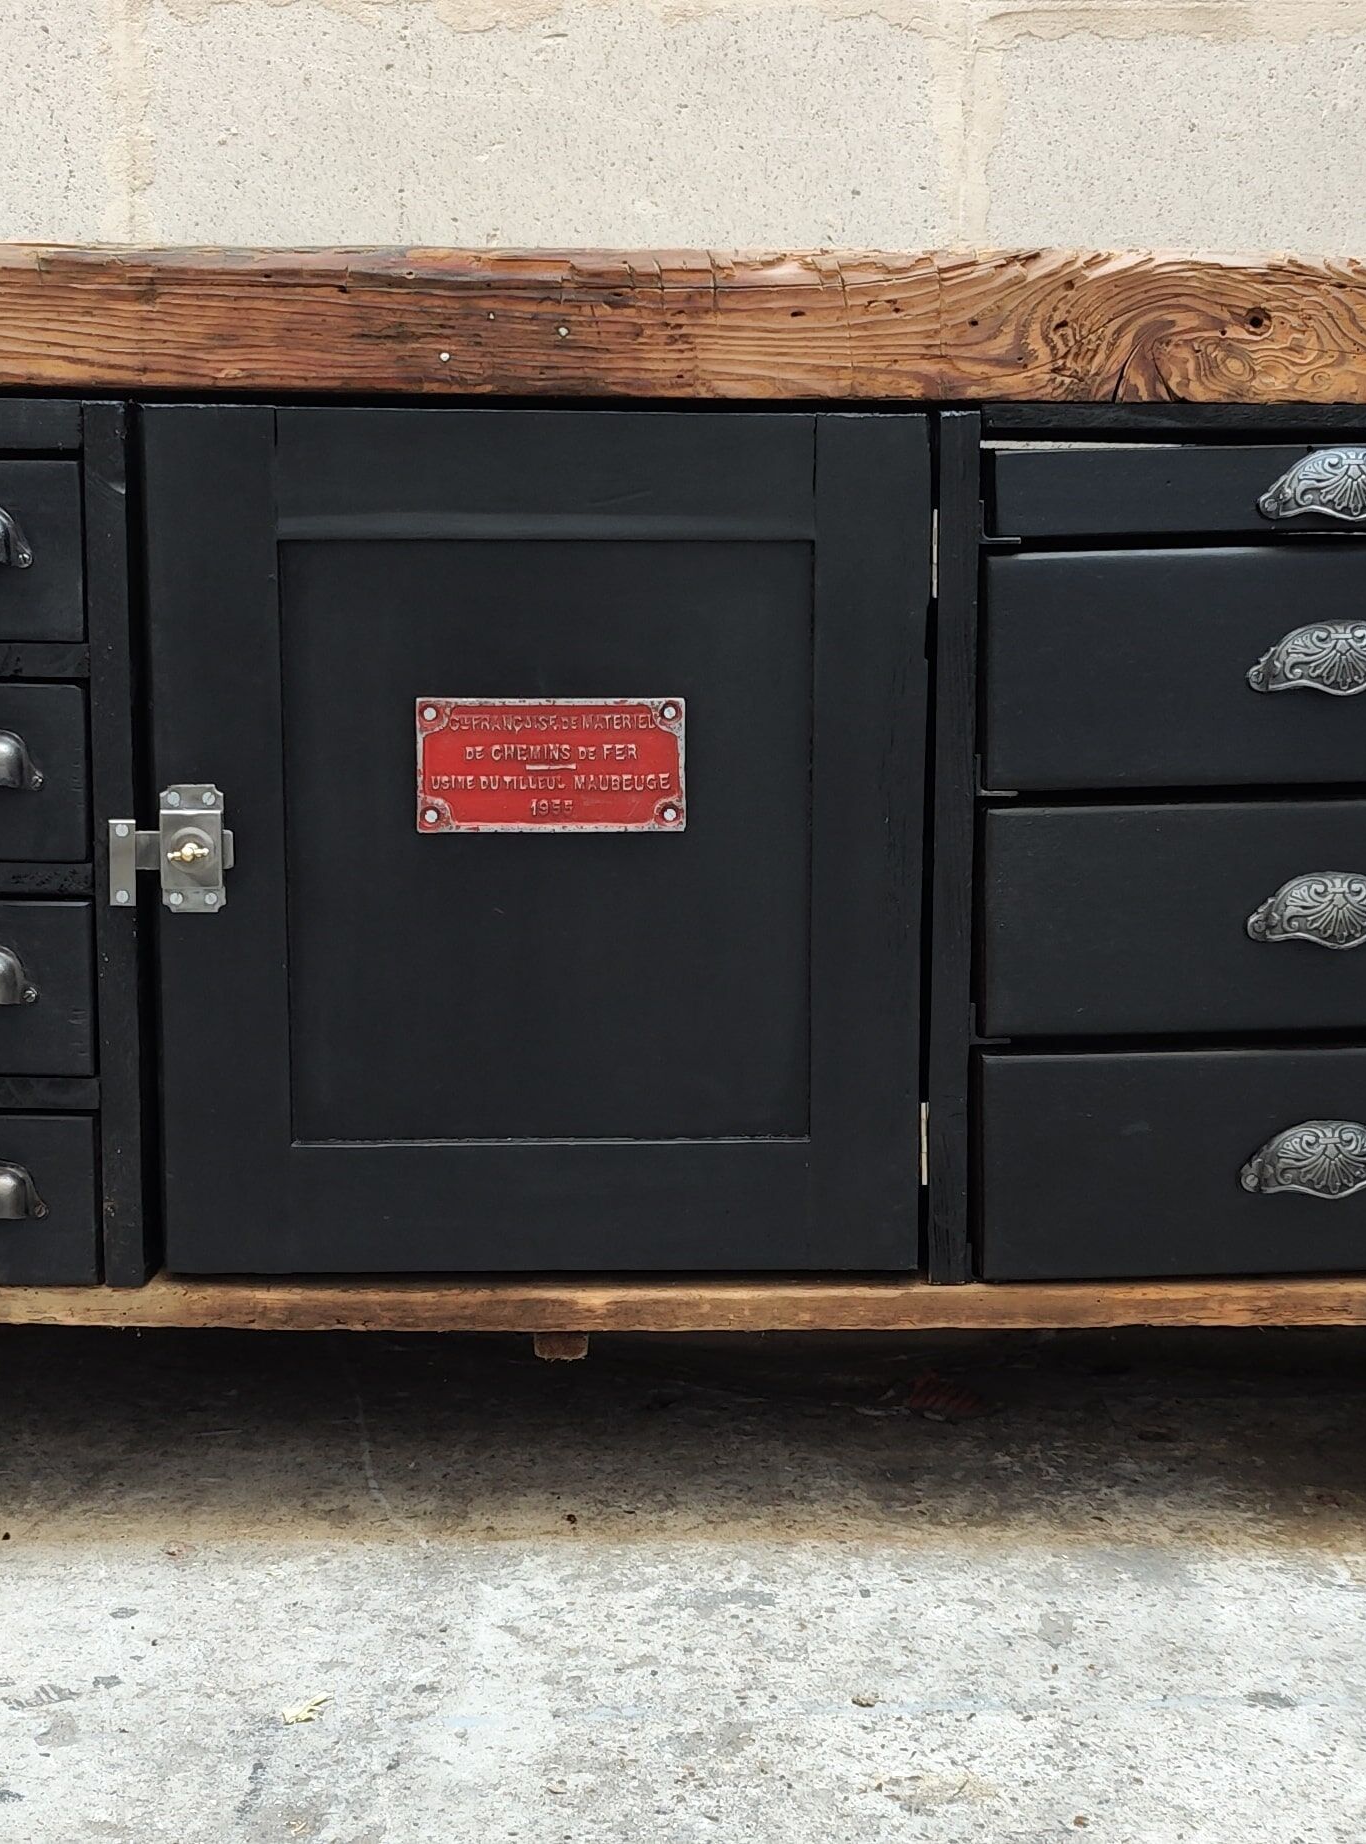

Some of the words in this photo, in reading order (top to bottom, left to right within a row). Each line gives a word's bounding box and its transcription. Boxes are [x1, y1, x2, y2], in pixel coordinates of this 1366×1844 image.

[465, 746, 485, 760] DE
[491, 743, 571, 761] CHEMINS
[577, 746, 597, 760] DE
[602, 743, 638, 760] FER
[479, 775, 499, 790] DU
[573, 773, 671, 791] MAUBEUGE
